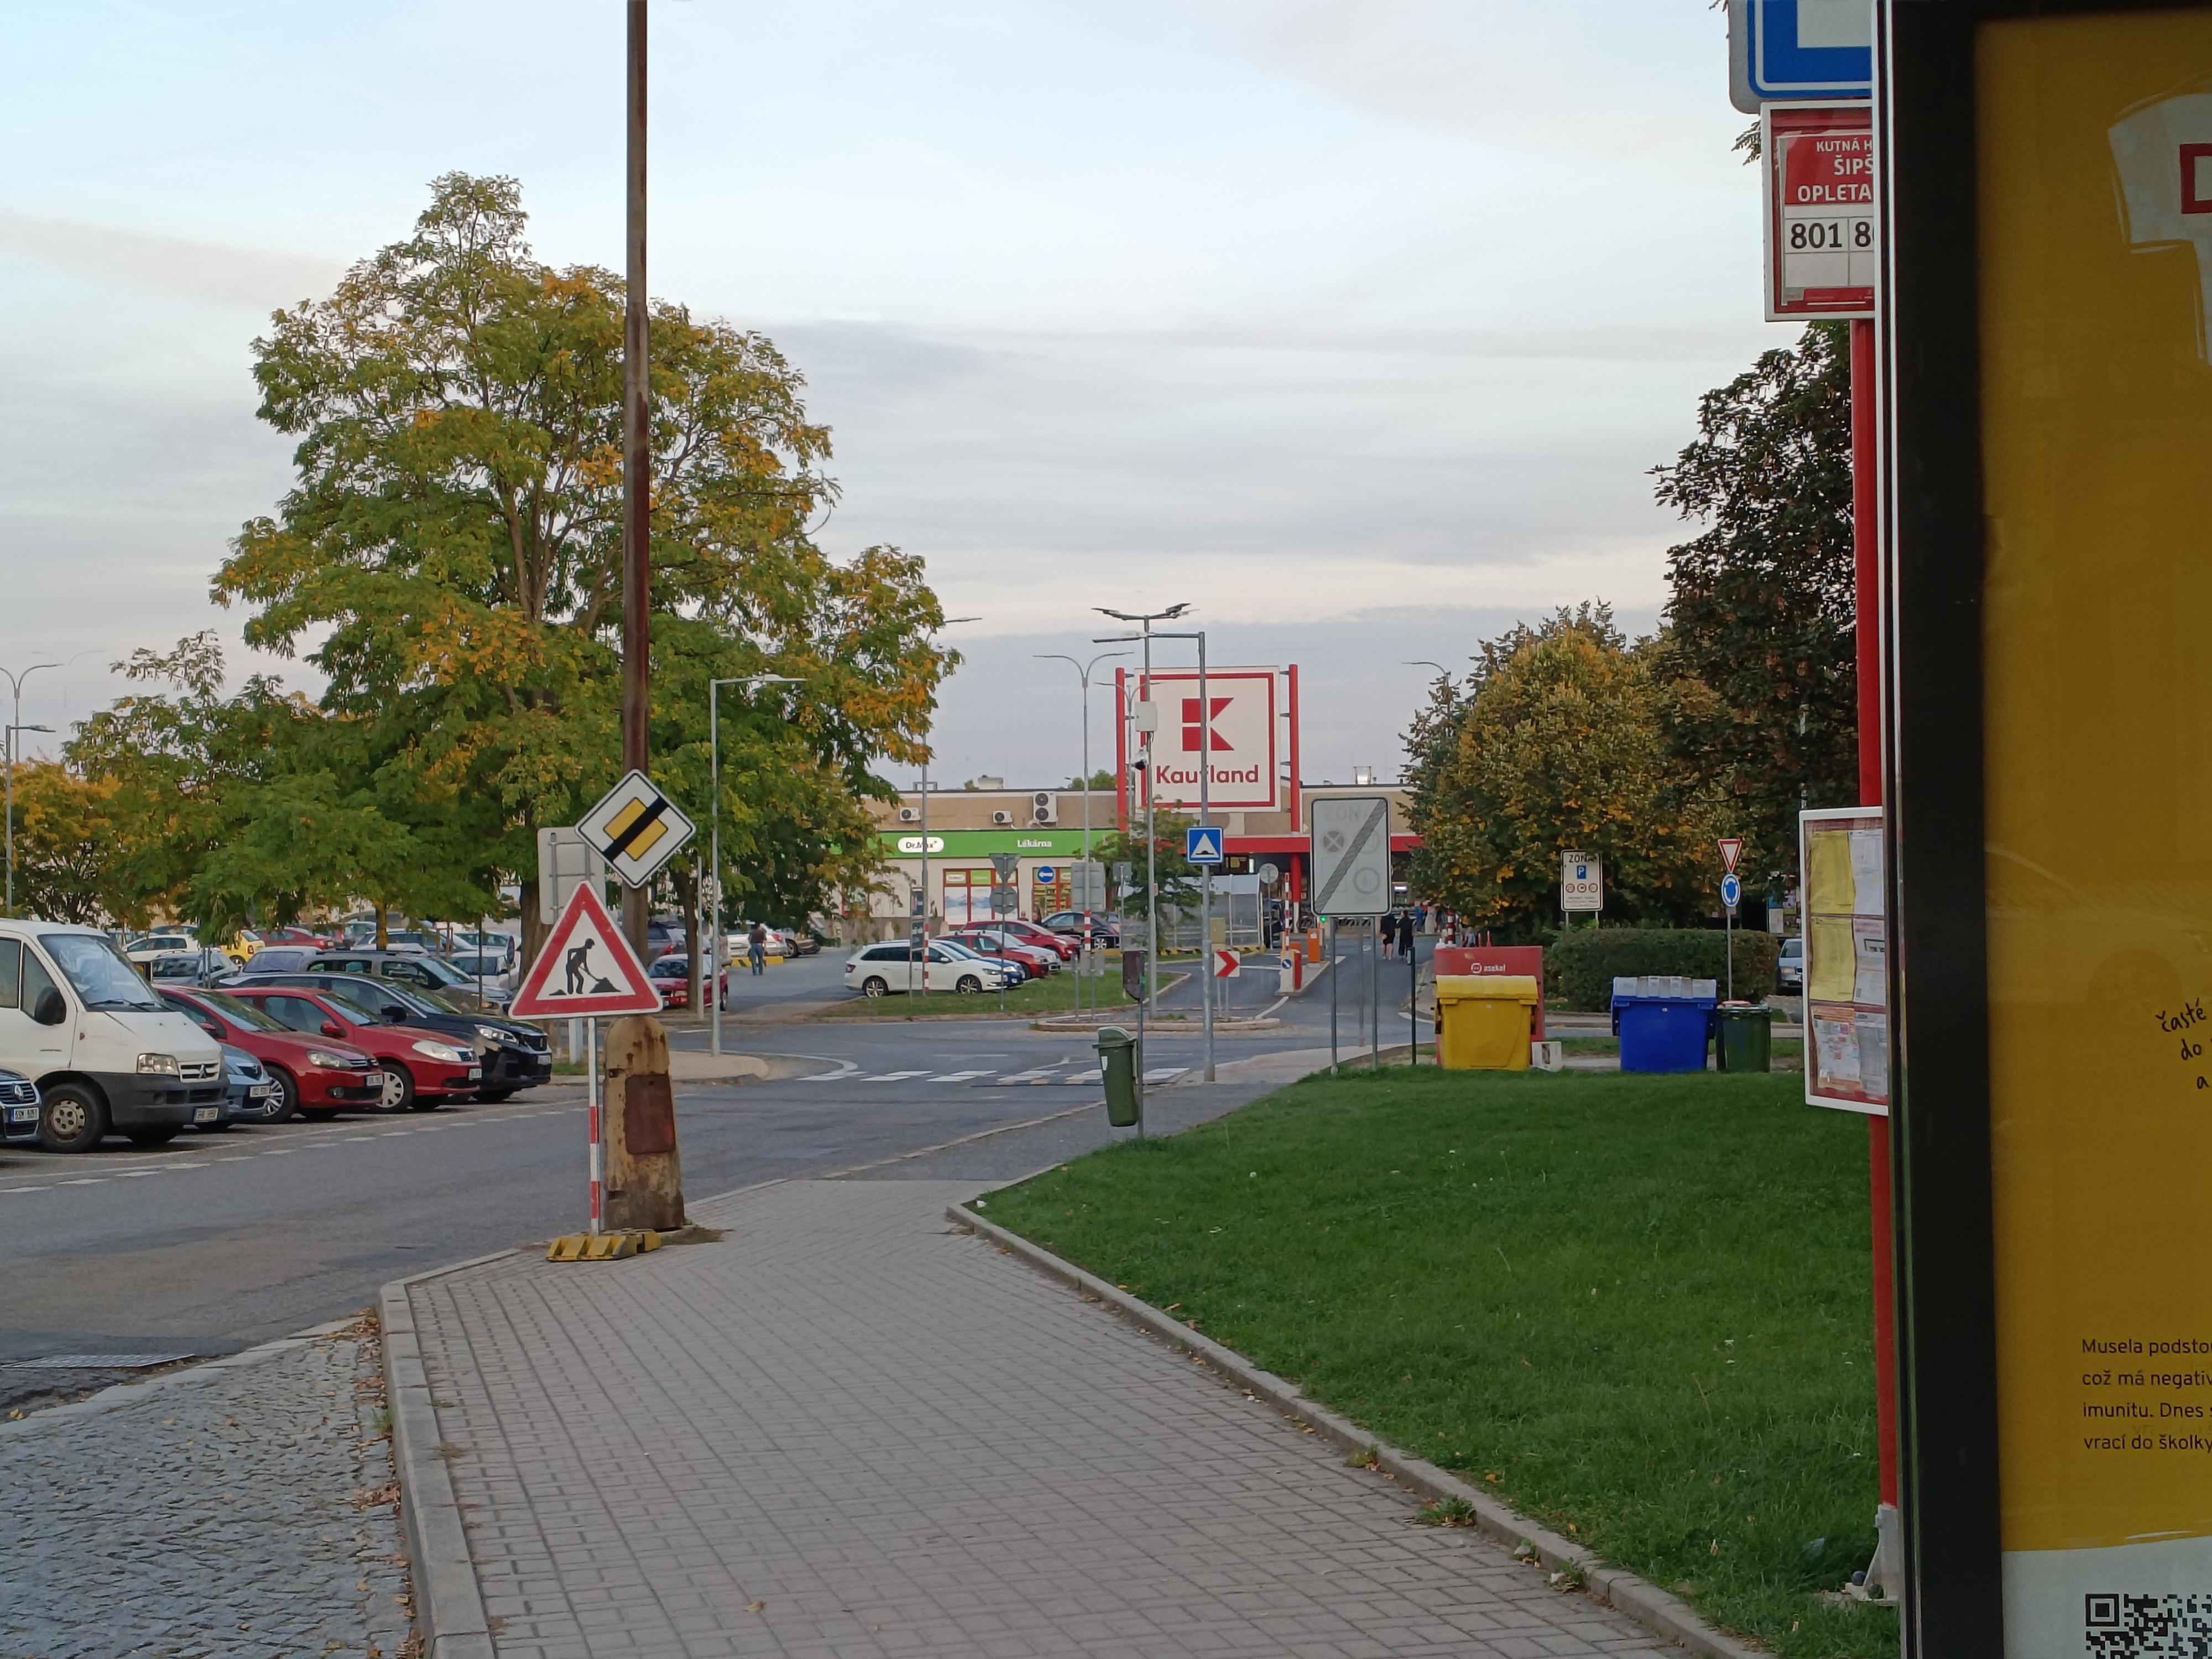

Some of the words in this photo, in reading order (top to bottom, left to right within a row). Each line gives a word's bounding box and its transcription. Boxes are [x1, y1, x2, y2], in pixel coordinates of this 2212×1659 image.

[1816, 137, 1860, 152] KUTNÁ
[1834, 154, 1874, 175] ŠIPŠ
[1797, 183, 1872, 202] OPLETA
[1790, 222, 1843, 249] 801
[1855, 221, 1874, 248] 8
[1156, 764, 1259, 784] Kauland
[2155, 998, 2206, 1032] časté
[2181, 1038, 2202, 1061] do
[2197, 1076, 2210, 1089] a
[2082, 1338, 2142, 1354] Musela
[2082, 1369, 2111, 1385] což
[2119, 1370, 2145, 1385] má
[2083, 1402, 2153, 1417] imunitu.
[2160, 1402, 2203, 1417] Dnes
[2084, 1433, 2126, 1449] vrací
[2132, 1434, 2152, 1449] do
[2159, 1433, 2212, 1453] školky
